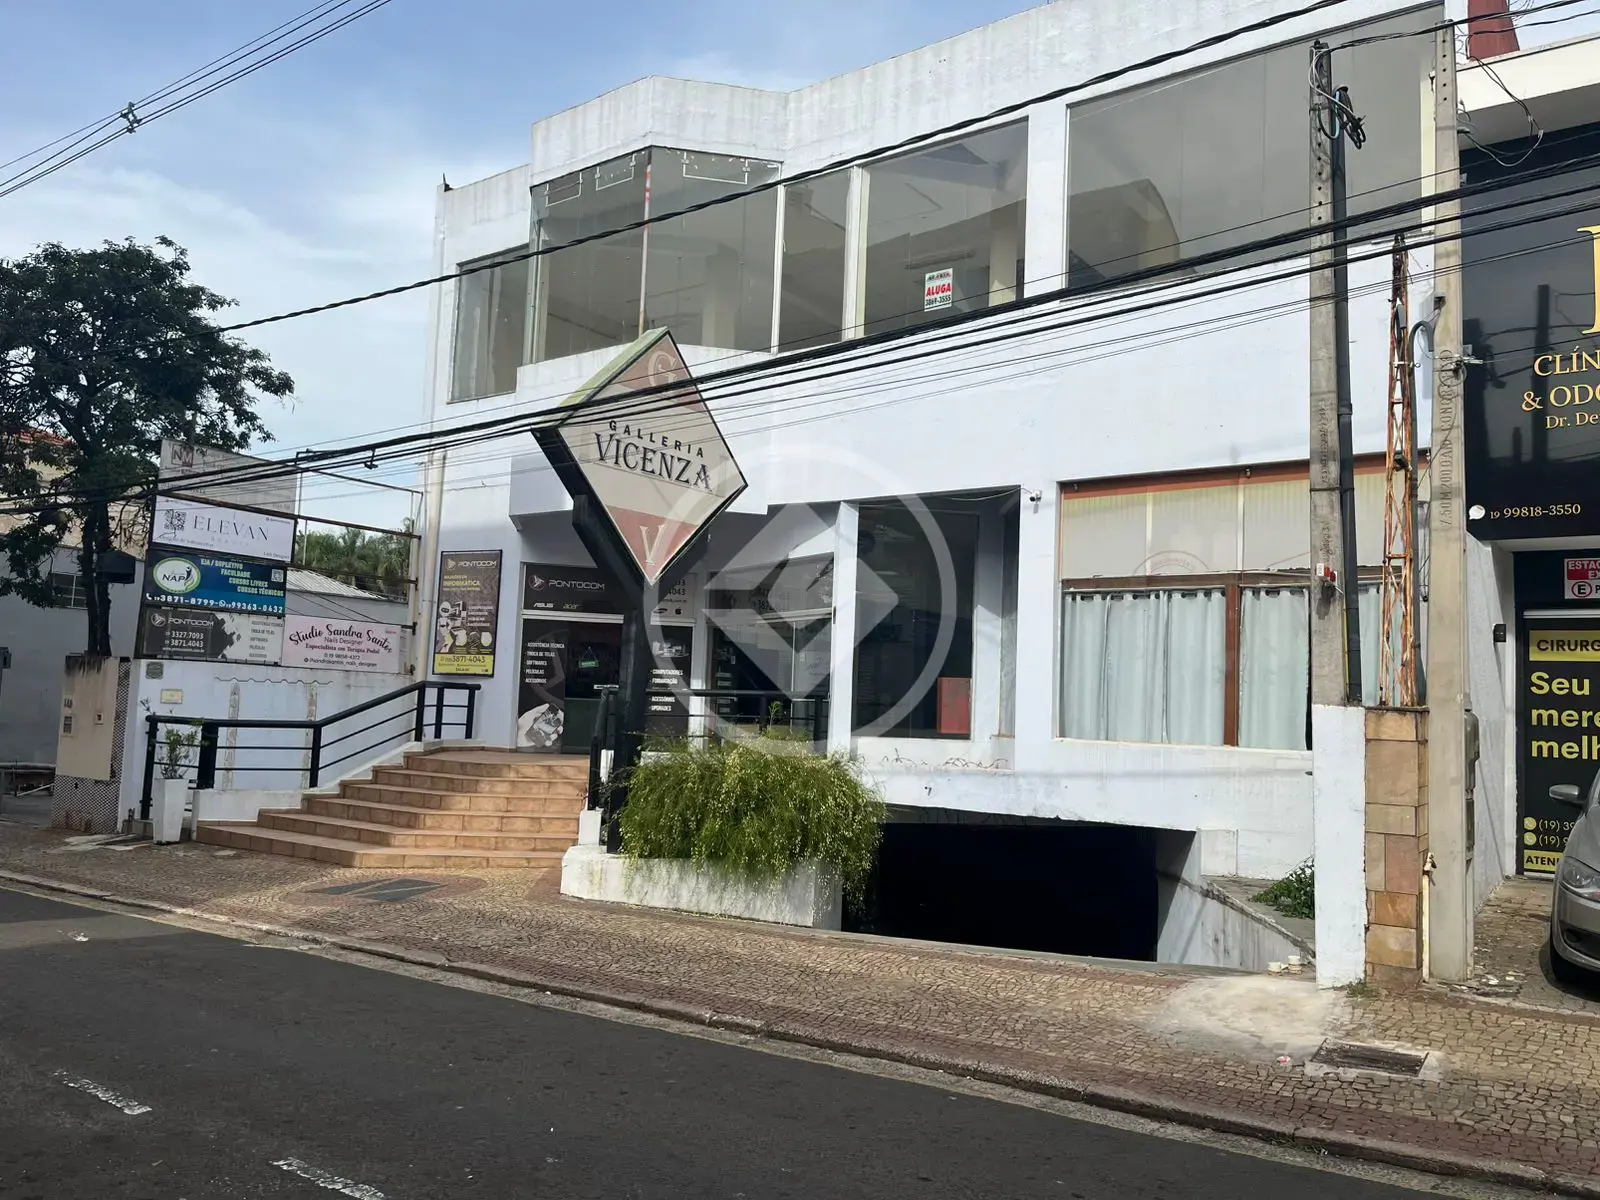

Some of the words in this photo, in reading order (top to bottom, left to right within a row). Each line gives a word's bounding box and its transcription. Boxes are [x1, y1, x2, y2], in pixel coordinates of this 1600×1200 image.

[926, 283, 951, 297] ALUGA
[647, 351, 677, 390] G
[1522, 391, 1543, 411] &
[1549, 384, 1600, 407] OD
[1546, 415, 1571, 429] Dr.
[1576, 411, 1600, 426] De
[609, 420, 704, 458] GALLERIA
[594, 432, 714, 492] VICENZA
[1490, 511, 1500, 519] 19
[1503, 504, 1581, 519] 99818-3550
[639, 523, 666, 566] V
[215, 560, 244, 570] SUPLETIVO
[220, 569, 251, 578] FACULDADE
[229, 577, 250, 586] CURSOS
[549, 579, 605, 590] PONTOCOM
[1577, 584, 1587, 595] E
[168, 617, 214, 626] PONTOCOM
[289, 626, 324, 645] Studio
[326, 624, 363, 639] Sandra
[366, 630, 393, 654] Santos
[1536, 640, 1600, 652] CIRURG
[306, 644, 336, 652] Especialista
[1530, 672, 1590, 696] Seu
[1539, 819, 1560, 832] (19)
[1539, 834, 1560, 848] (19)
[1526, 856, 1560, 866] ATEN
